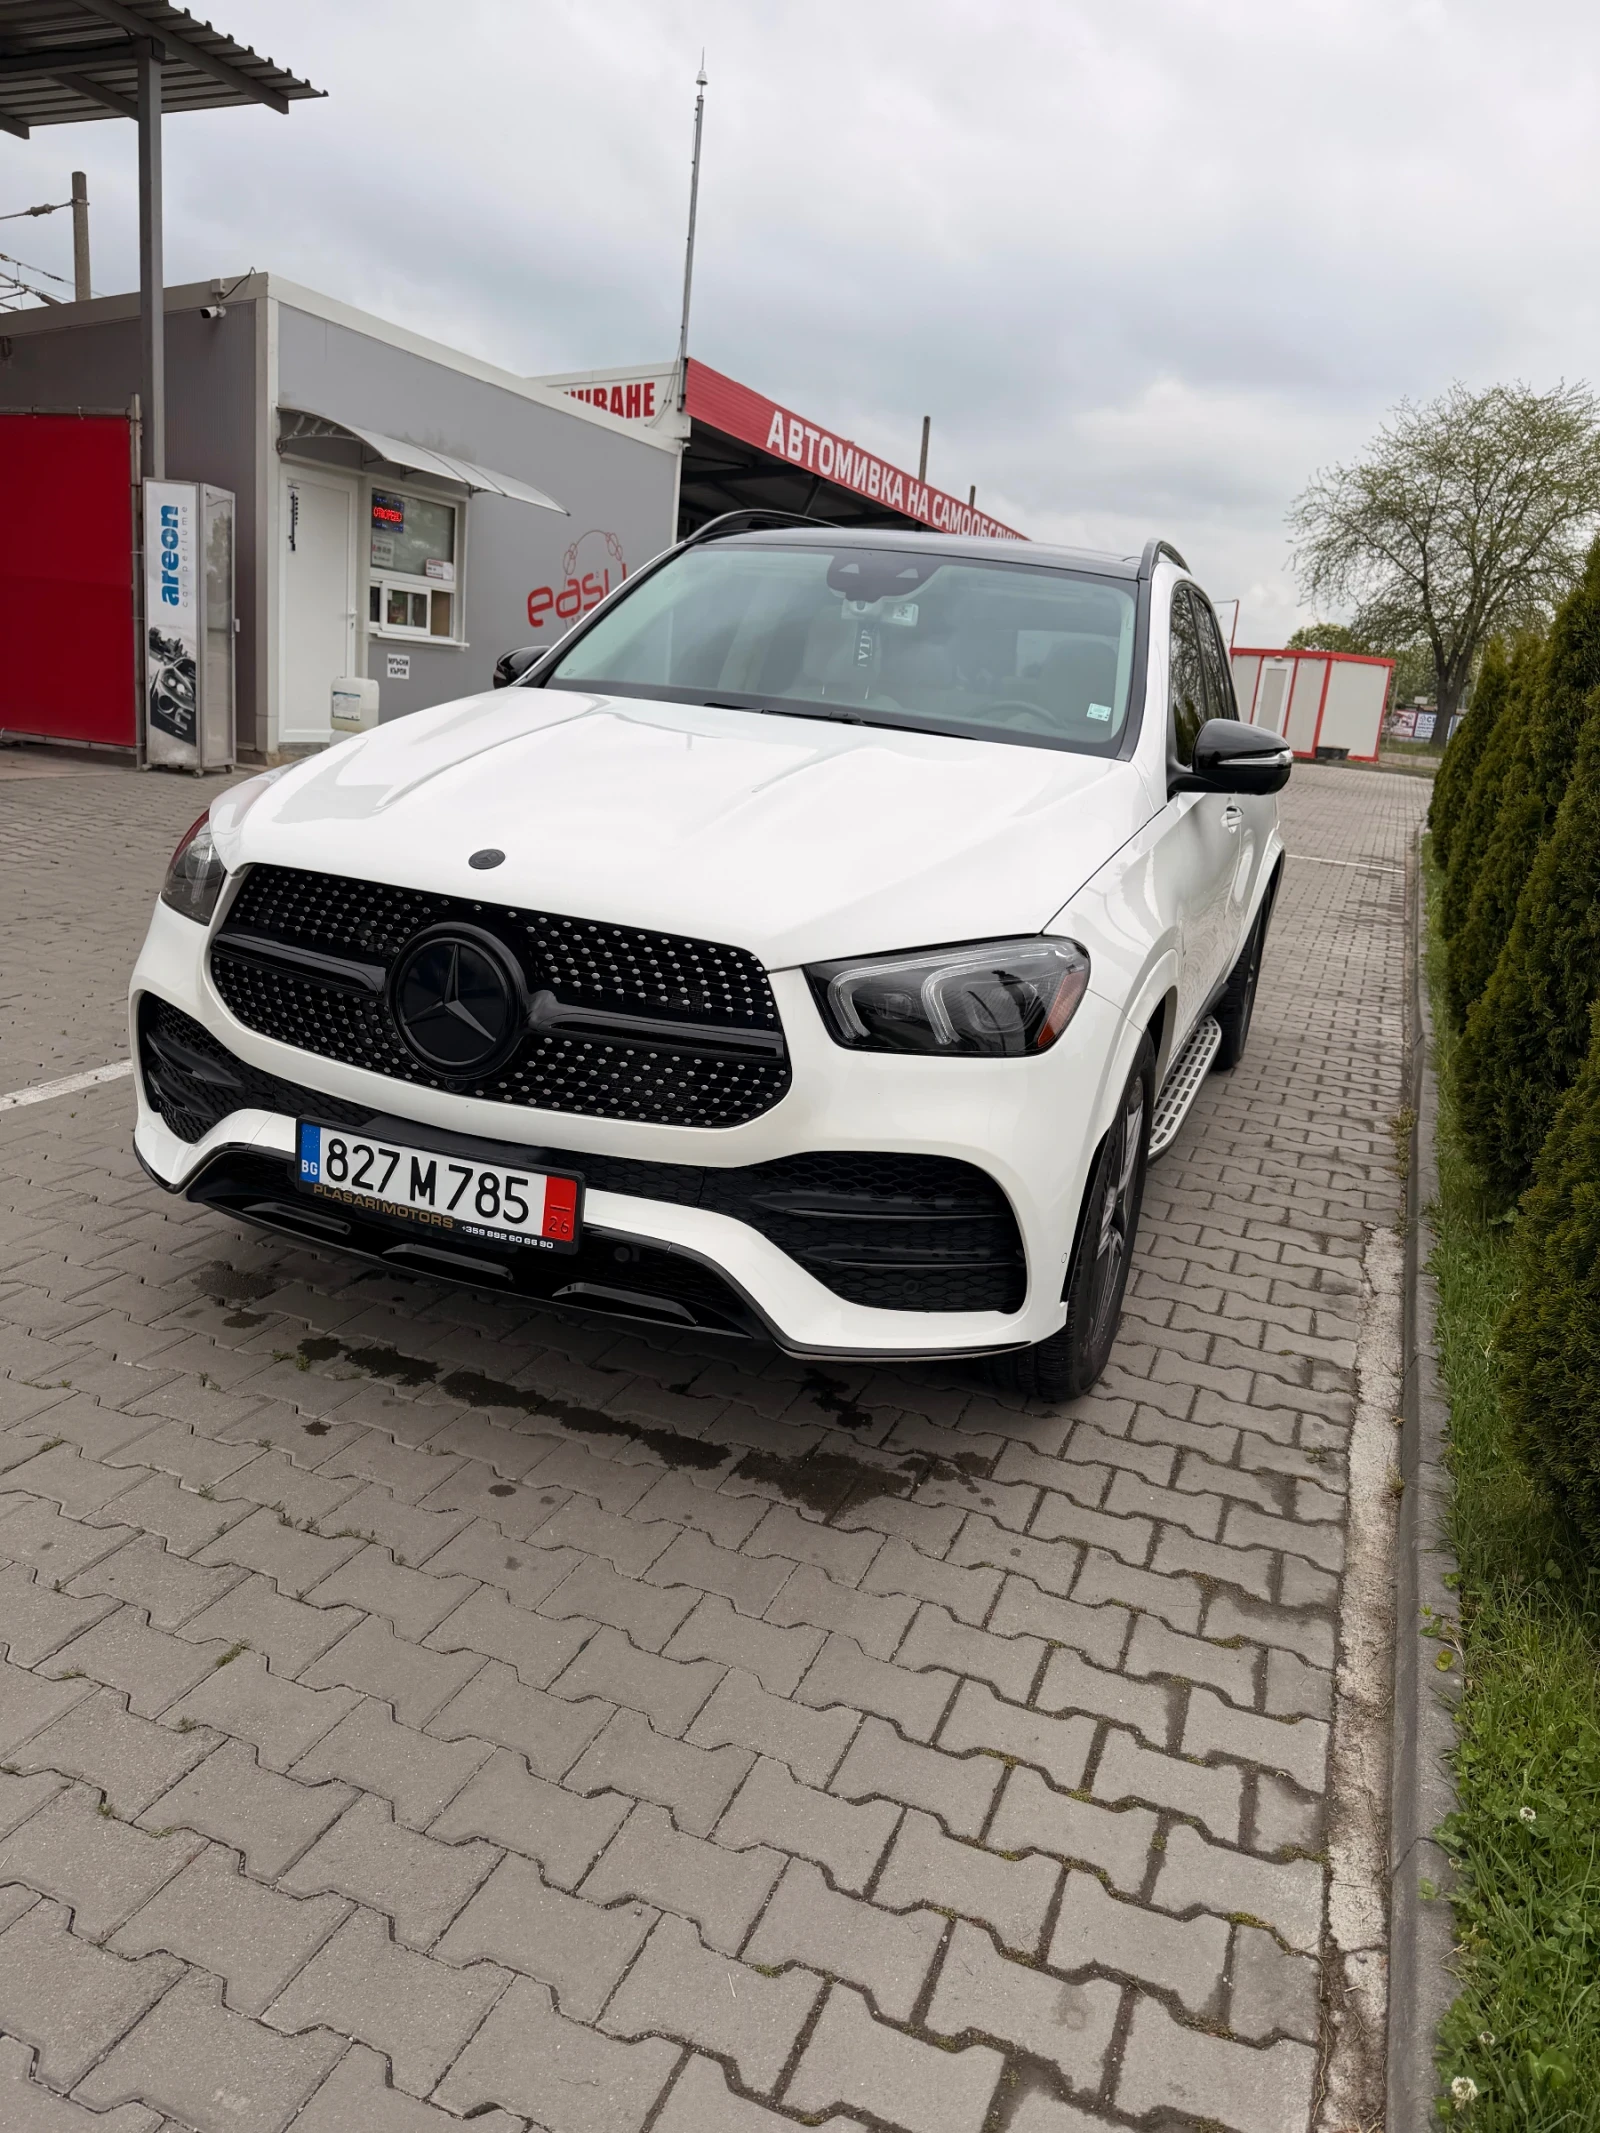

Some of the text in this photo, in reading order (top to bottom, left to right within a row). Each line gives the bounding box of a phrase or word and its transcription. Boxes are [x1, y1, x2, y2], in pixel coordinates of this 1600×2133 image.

[766, 410, 904, 510] АВТОМИВКА
[907, 480, 929, 521] НА
[160, 505, 180, 606] areon
[180, 506, 189, 608] car perfume
[301, 1159, 318, 1176] BG
[326, 1138, 529, 1224] 827 M 785
[313, 1183, 454, 1229] PLASARI MOTORS
[461, 1225, 485, 1236] +359
[508, 1234, 523, 1243] 60
[548, 1215, 570, 1234] 26
